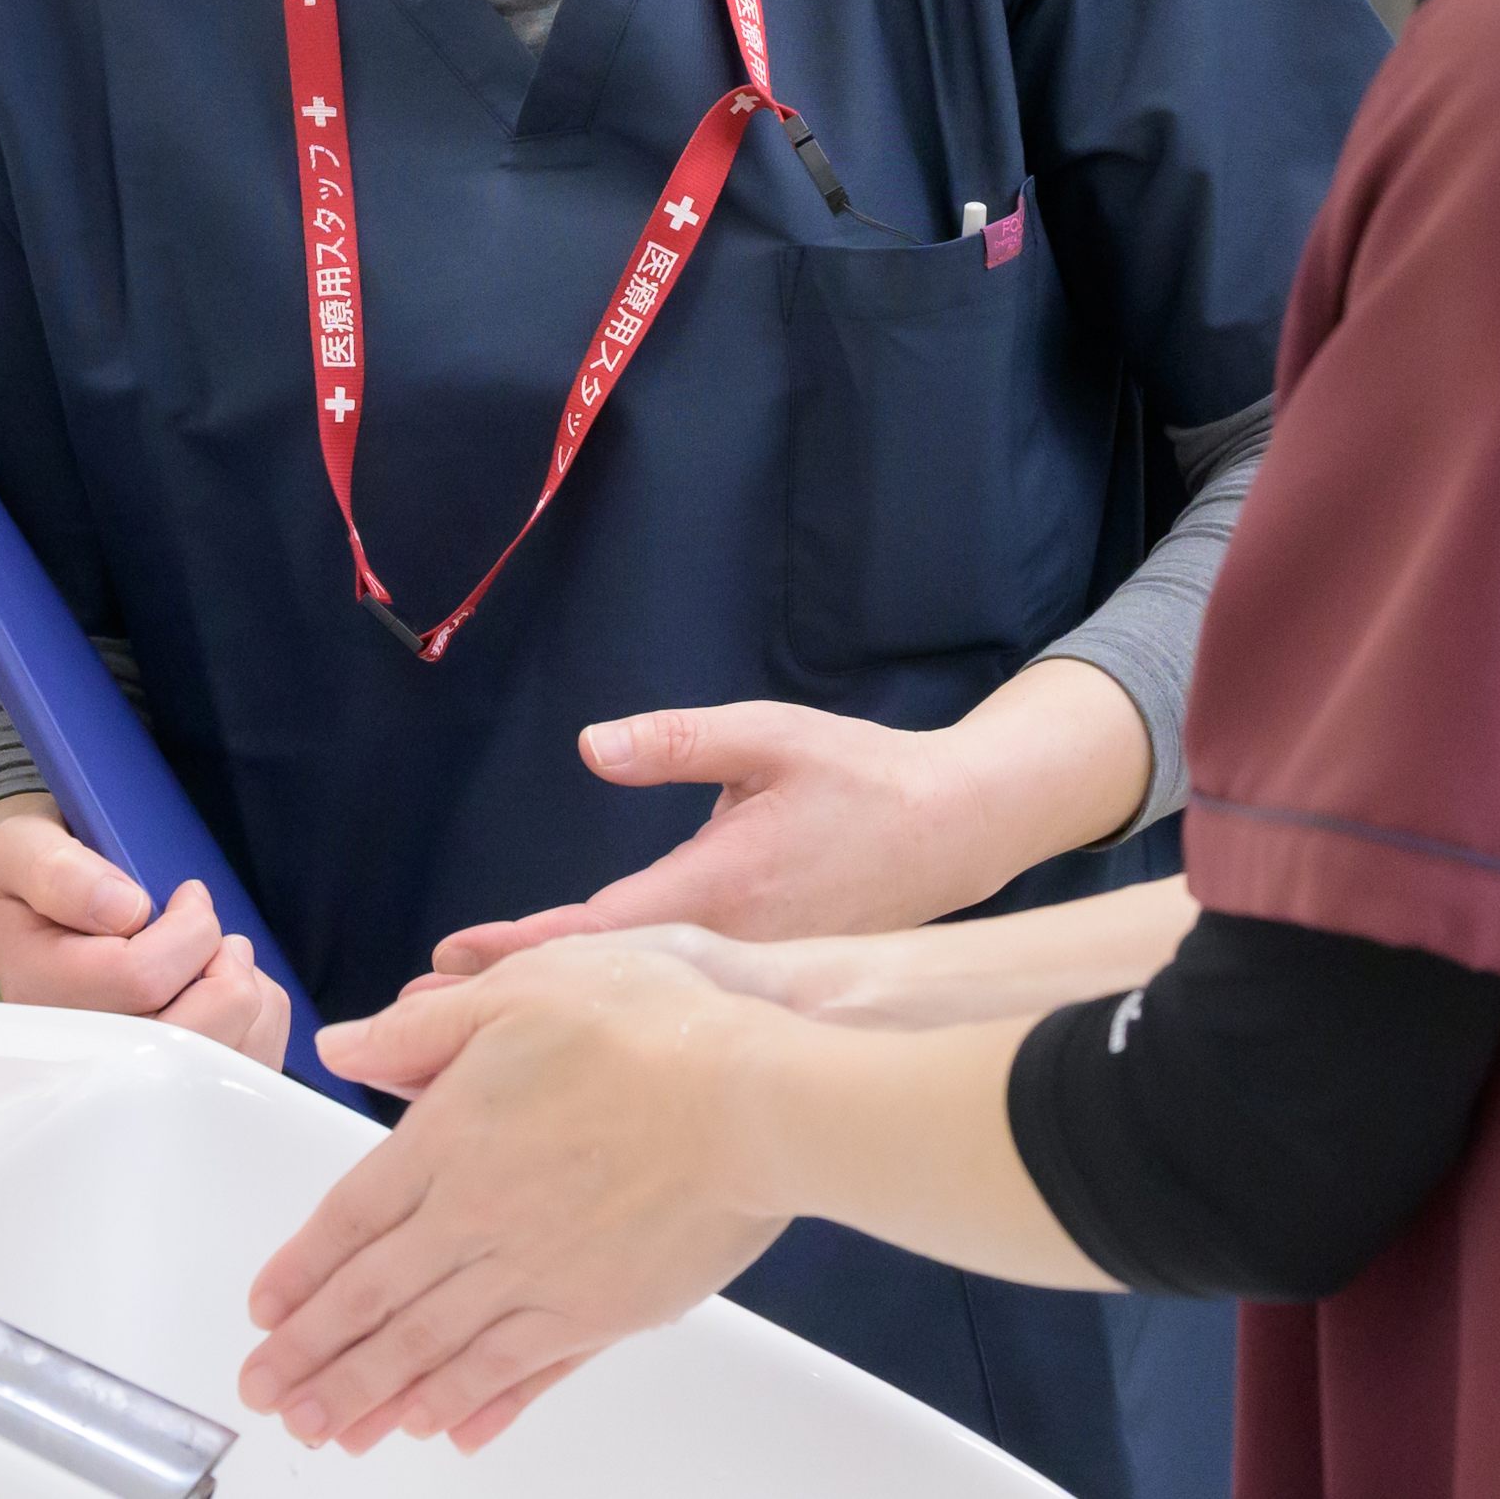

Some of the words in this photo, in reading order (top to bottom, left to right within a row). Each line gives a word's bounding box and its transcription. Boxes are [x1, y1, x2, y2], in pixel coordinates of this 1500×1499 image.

[308, 144, 357, 369] 医療用スタッフ
[557, 240, 679, 474] 医療用スタッフ
